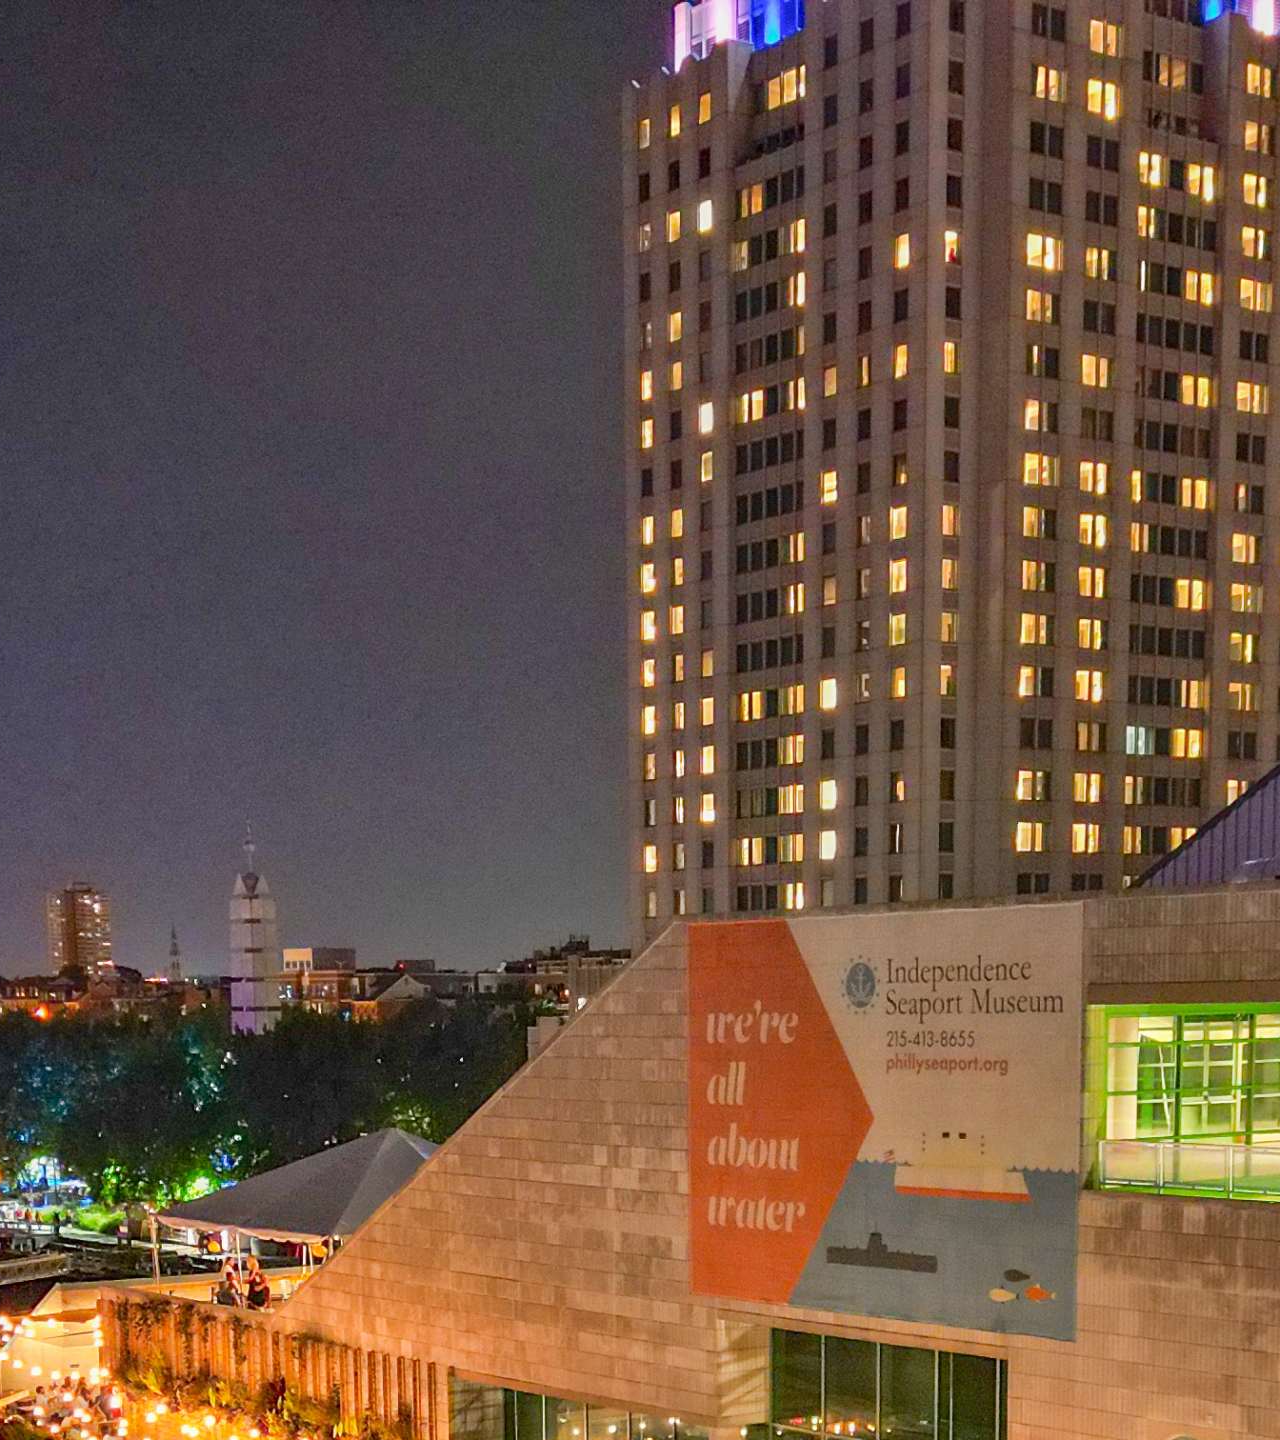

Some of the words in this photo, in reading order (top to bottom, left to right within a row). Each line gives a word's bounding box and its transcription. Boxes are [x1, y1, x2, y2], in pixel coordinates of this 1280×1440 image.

[886, 954, 1032, 992] Independence
[706, 1000, 799, 1044] we're
[885, 989, 963, 1024] Seaport
[970, 988, 1064, 1014] Museum
[886, 1029, 976, 1048] 215-413-8655
[885, 1052, 1009, 1076] phillyseaport.org
[706, 1061, 746, 1106] all
[706, 1122, 800, 1171] about
[707, 1195, 806, 1233] water
